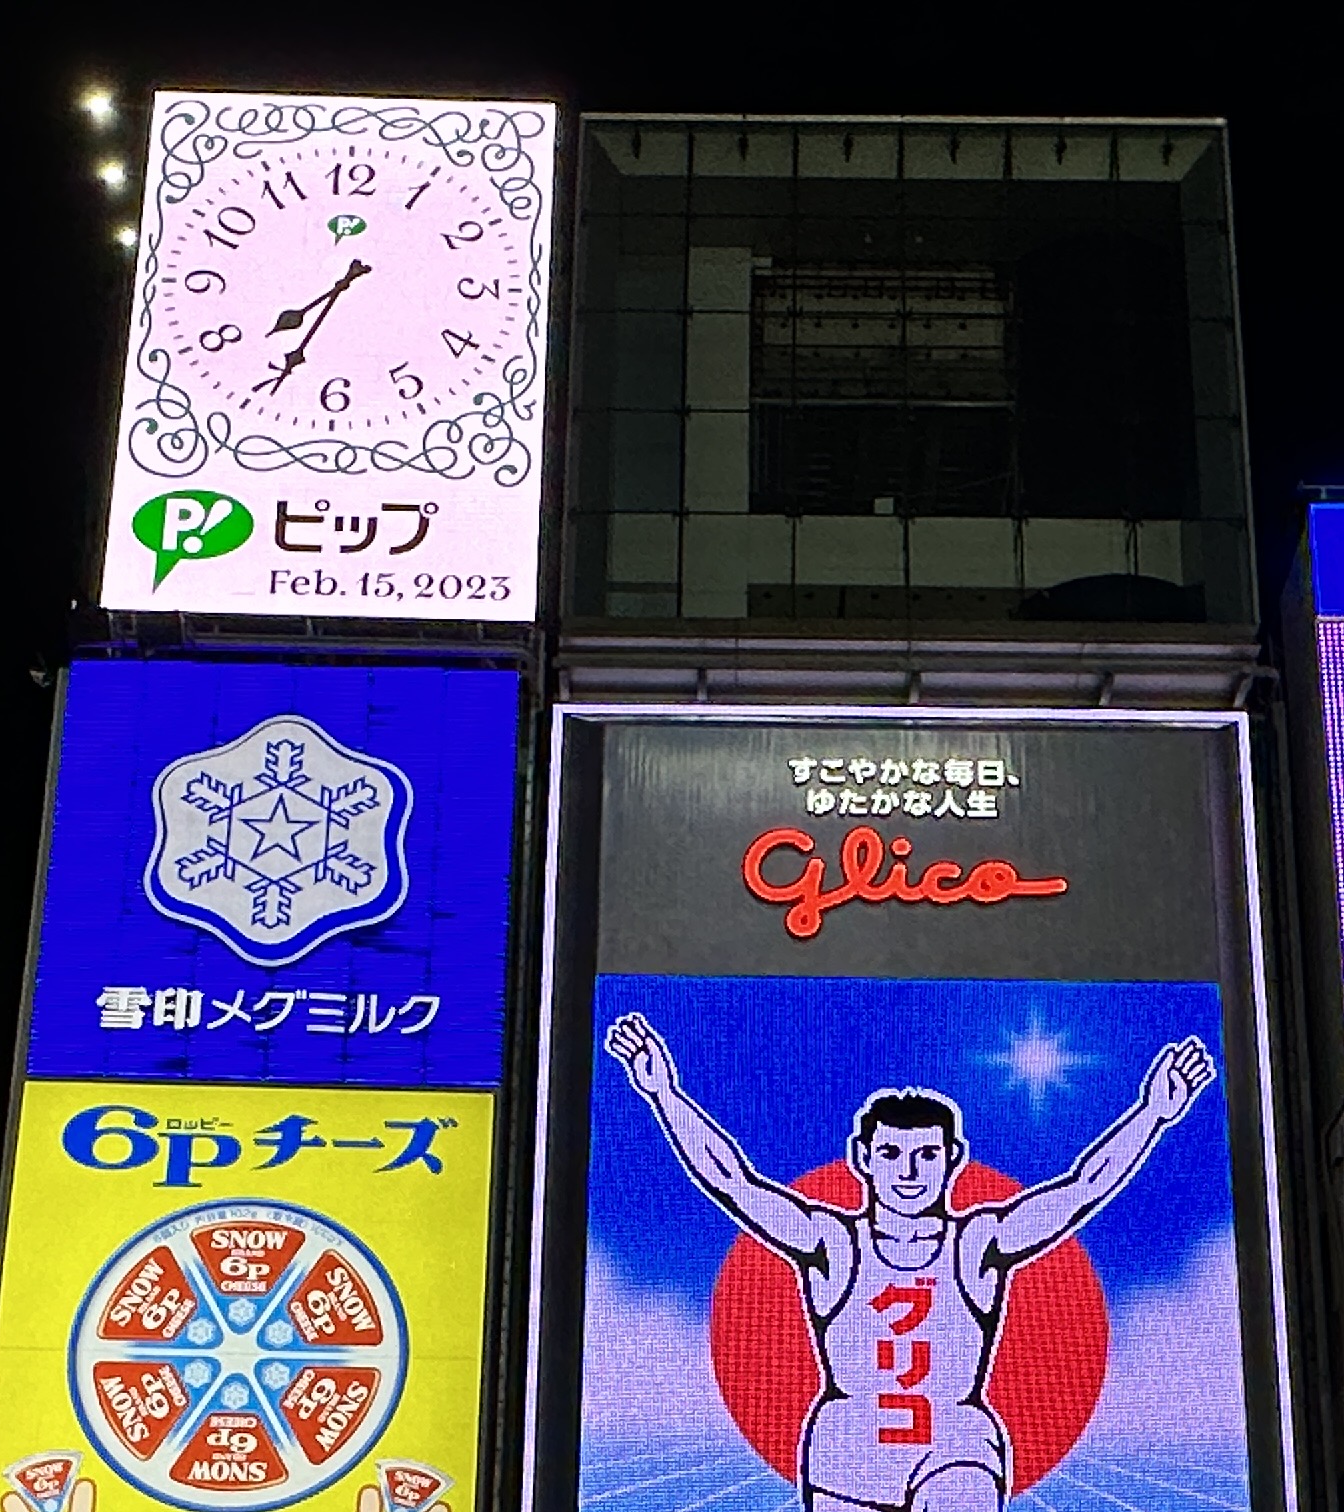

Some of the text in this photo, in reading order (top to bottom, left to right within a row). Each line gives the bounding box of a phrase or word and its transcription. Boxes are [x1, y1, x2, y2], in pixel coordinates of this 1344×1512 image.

[261, 171, 308, 210] 11
[325, 164, 377, 196] 12
[405, 182, 431, 209] 1
[204, 207, 256, 250] 10
[439, 219, 484, 250] 2
[185, 270, 226, 294] 9
[458, 276, 500, 300] 3
[199, 324, 242, 352] 8
[440, 326, 480, 359] 4
[320, 377, 352, 412] 6
[389, 361, 424, 400] 5
[274, 499, 440, 556] ピップ
[268, 570, 346, 598] Feb.
[414, 572, 513, 600] 2023
[787, 757, 1022, 788] すこやかな毎日、
[804, 787, 999, 819] ゆたかな人生
[741, 826, 1070, 939] Glico
[95, 985, 441, 1035] 雪印メグミルク
[210, 1230, 288, 1251] SNOW
[110, 1258, 165, 1328] SNOW
[325, 1266, 376, 1333] SNOW
[866, 1276, 937, 1445] グリコ
[98, 1375, 150, 1444] SNOW
[314, 1380, 370, 1452] SNOW
[187, 1460, 269, 1483] SNOW
